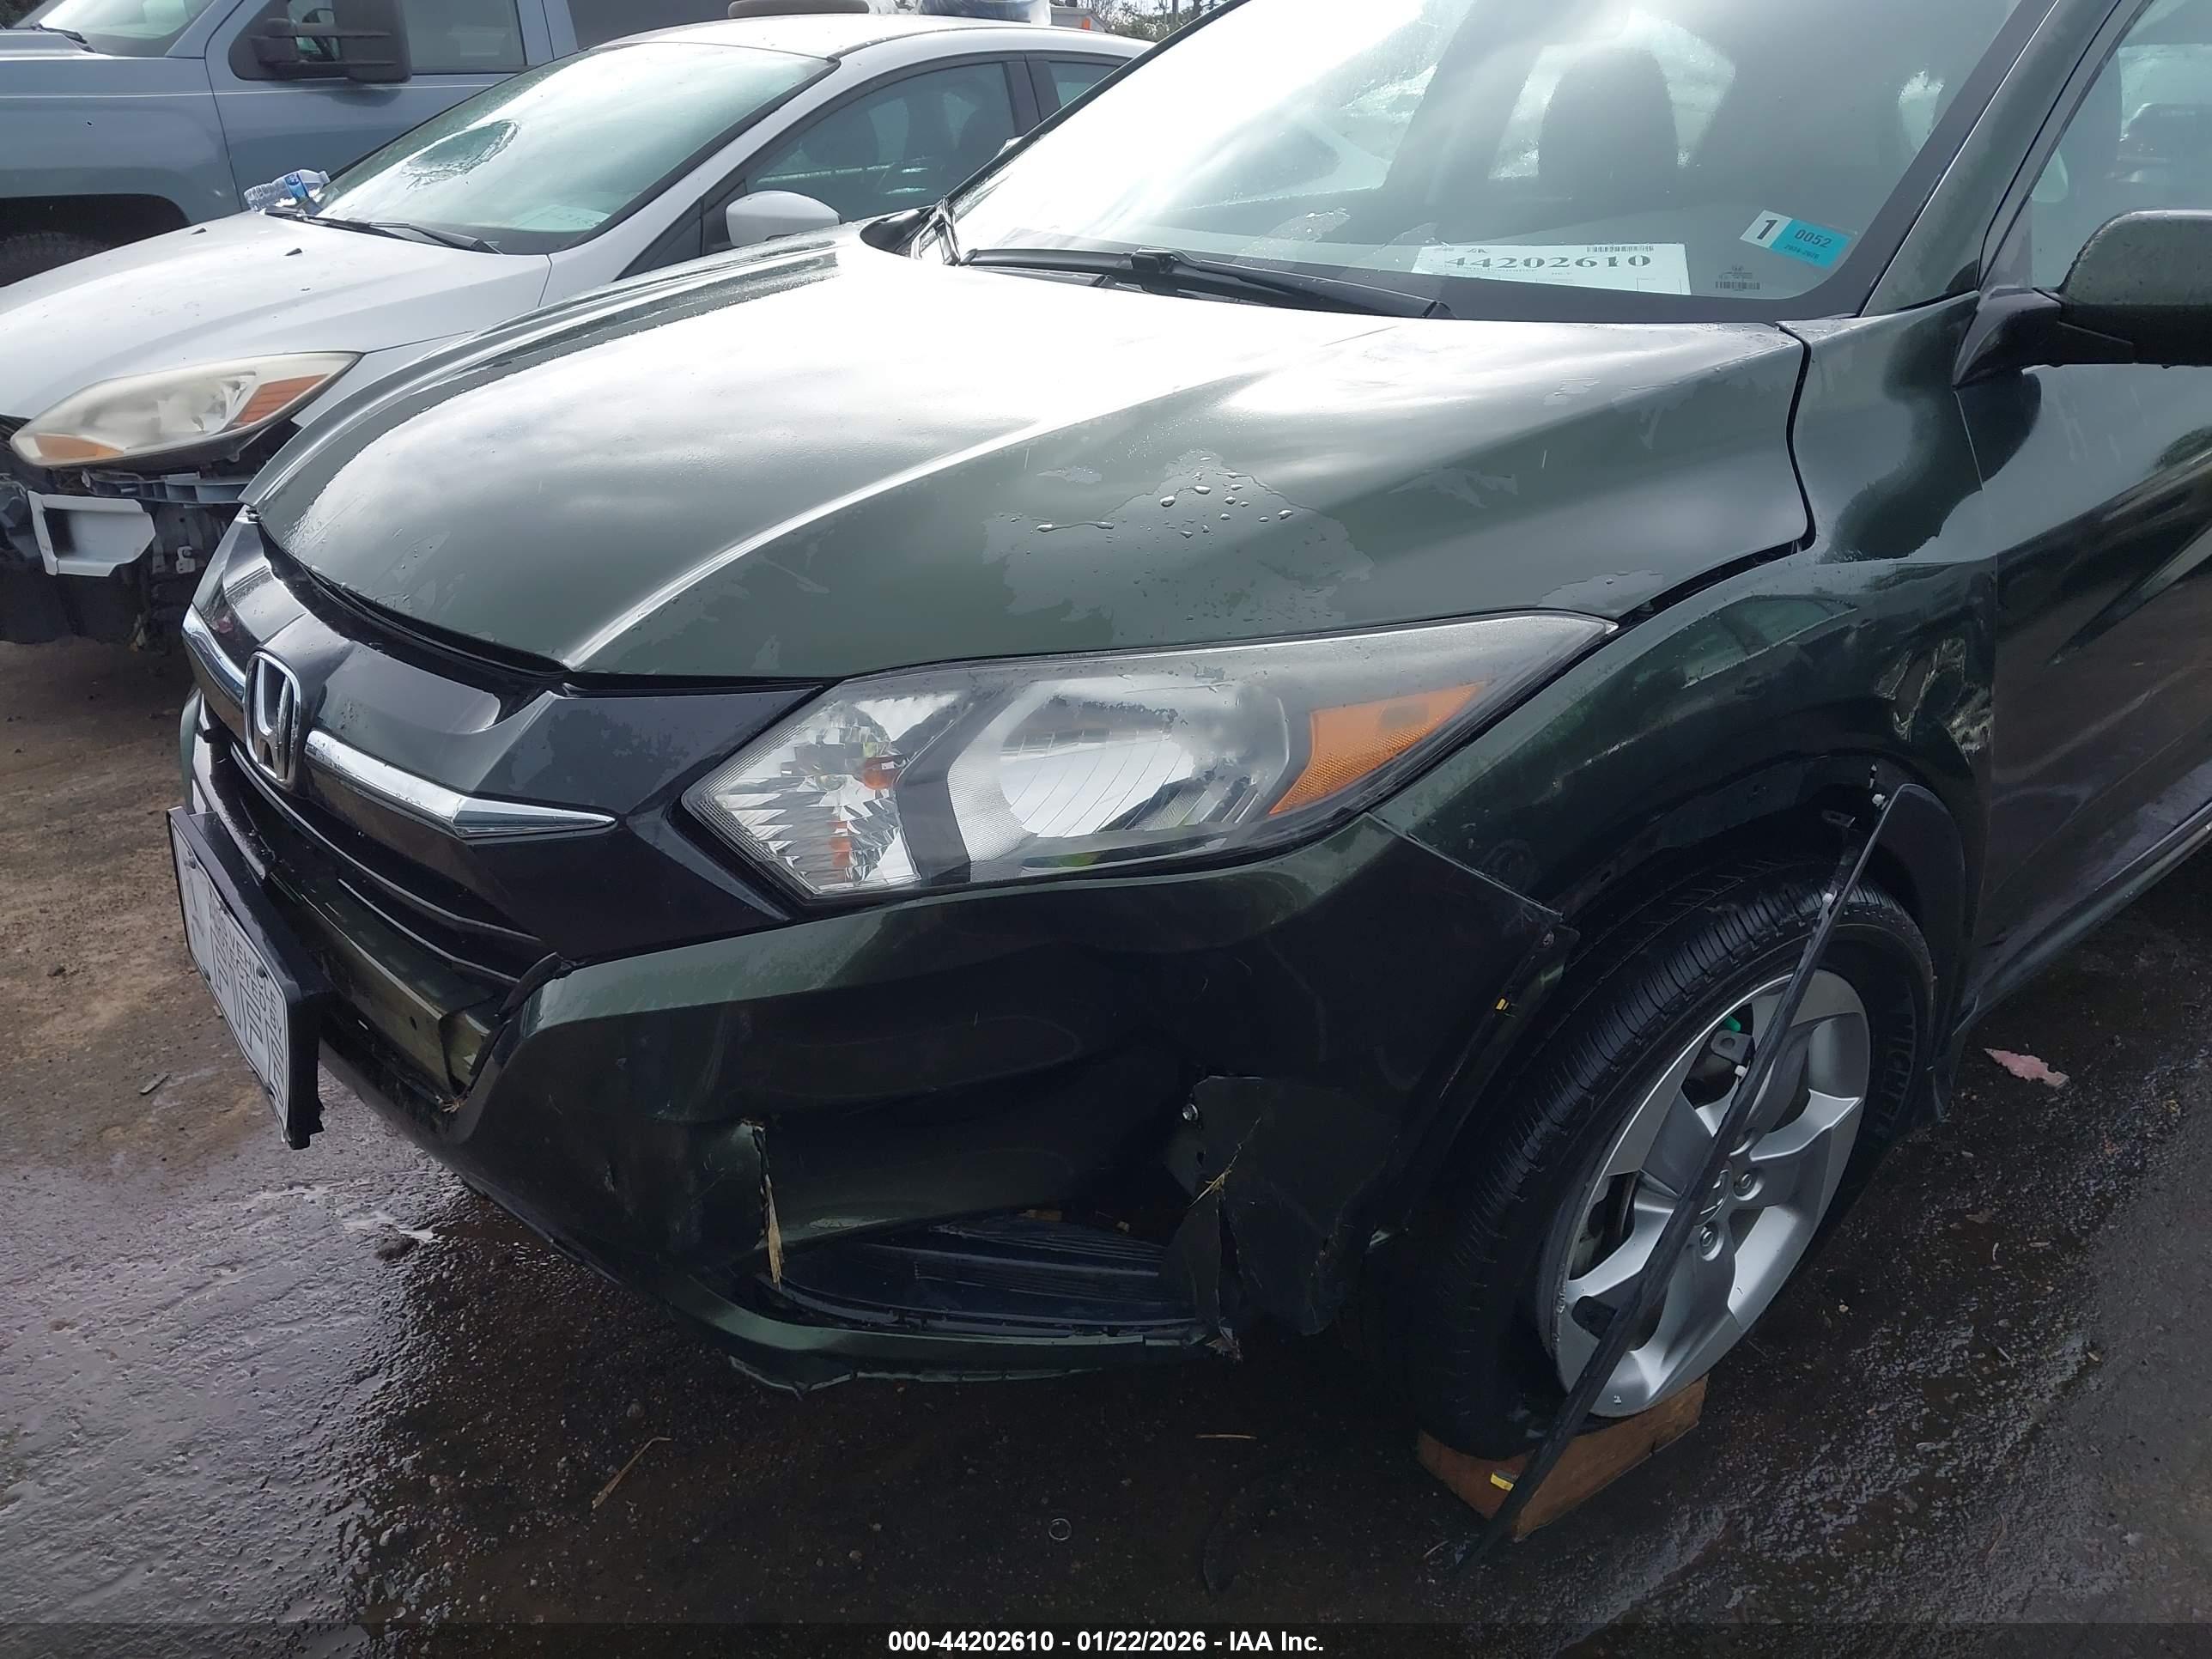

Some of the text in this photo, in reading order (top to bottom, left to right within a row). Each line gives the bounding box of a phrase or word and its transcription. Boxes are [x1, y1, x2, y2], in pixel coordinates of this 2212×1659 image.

[1756, 219, 1778, 240] 1
[1794, 228, 1832, 248] 0052
[1444, 255, 1652, 269] 44202610
[228, 929, 277, 1007] VEHICLE
[270, 1008, 282, 1040] BY
